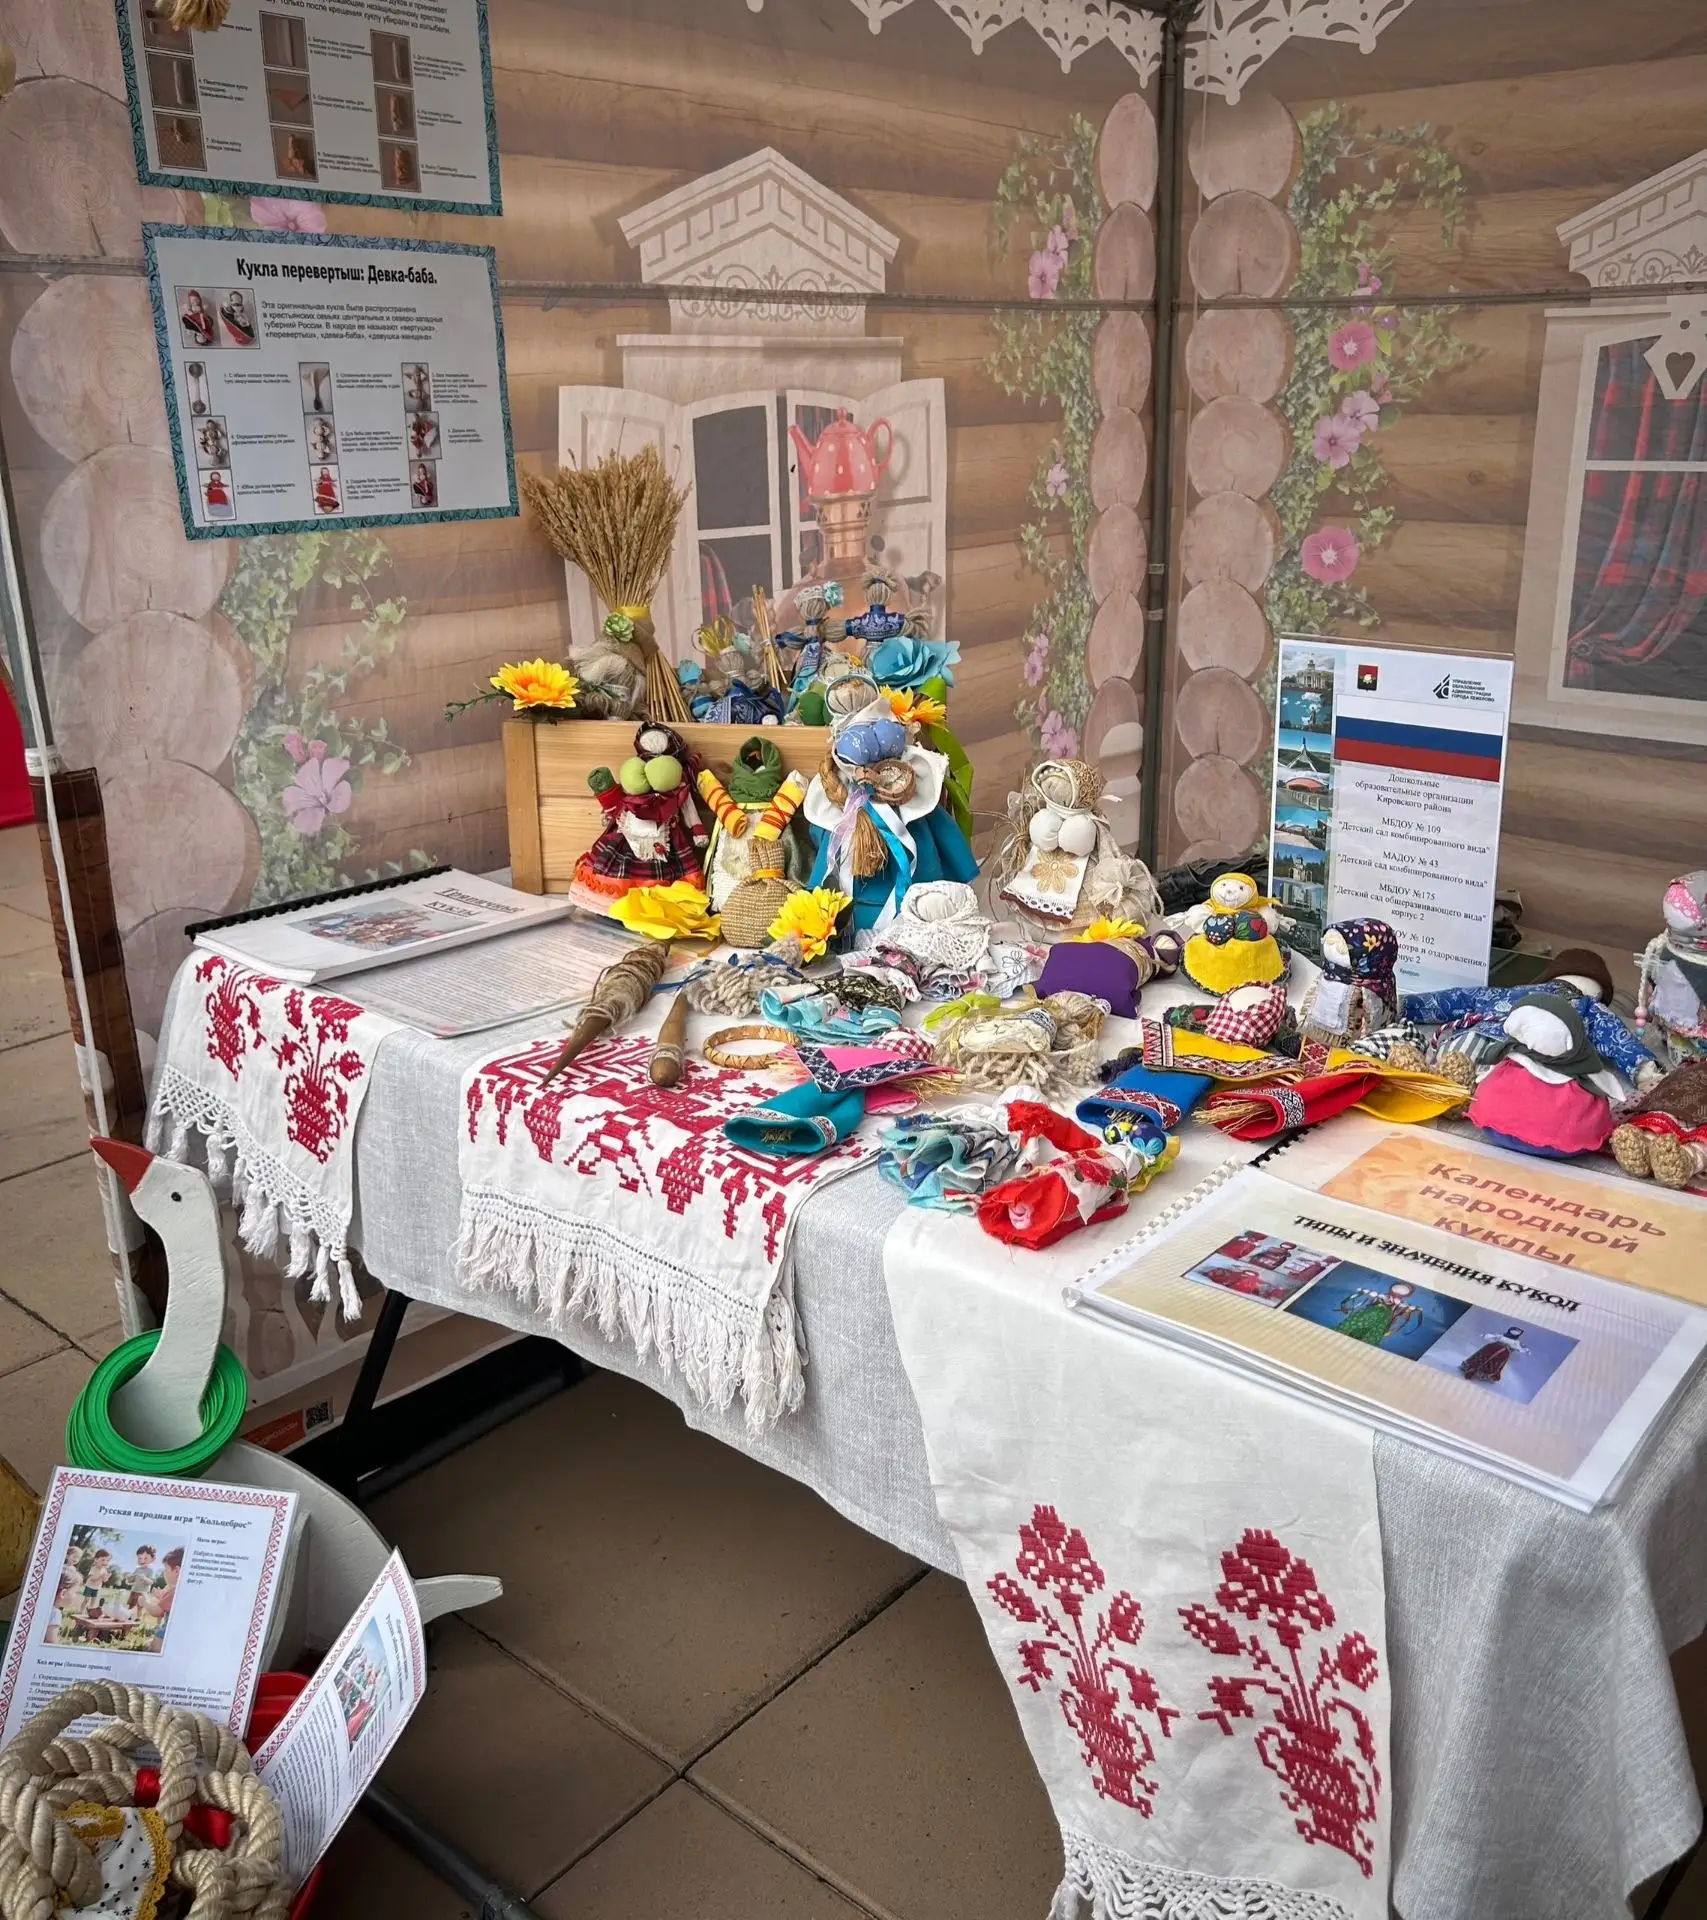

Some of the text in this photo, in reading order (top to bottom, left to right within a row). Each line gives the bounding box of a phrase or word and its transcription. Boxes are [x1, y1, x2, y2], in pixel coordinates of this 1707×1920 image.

[306, 2, 327, 11] после
[236, 257, 438, 285] Кукла перевертыш: Девка-баба.
[1388, 773, 1440, 788] Дошкольные
[1355, 780, 1474, 805] образовательные организации
[1376, 794, 1452, 812] Кировского района
[1382, 817, 1441, 833] МБДОУ № 109
[1390, 831, 1465, 849] комбинированного
[1383, 851, 1439, 868] МАДОУ № 43
[1374, 862, 1388, 870] сад
[1389, 865, 1463, 884] комбинированного
[1379, 882, 1410, 894] МБДОУ
[1370, 894, 1384, 902] сад
[1385, 896, 1461, 916] общеразвивающего
[1391, 909, 1418, 920] корпус
[1409, 933, 1419, 941] №
[1421, 935, 1435, 945] 102
[1416, 956, 1421, 964] 2
[1428, 1163, 1666, 1237] Календарь
[1419, 1185, 1640, 1253] народной
[1433, 1217, 1576, 1266] куклы
[1294, 1215, 1582, 1312] ТИПЫ И ЗНАЧЕНИЯ КУКОЛ
[98, 1505, 132, 1517] Русская
[133, 1510, 172, 1521] народная
[174, 1515, 193, 1524] игра
